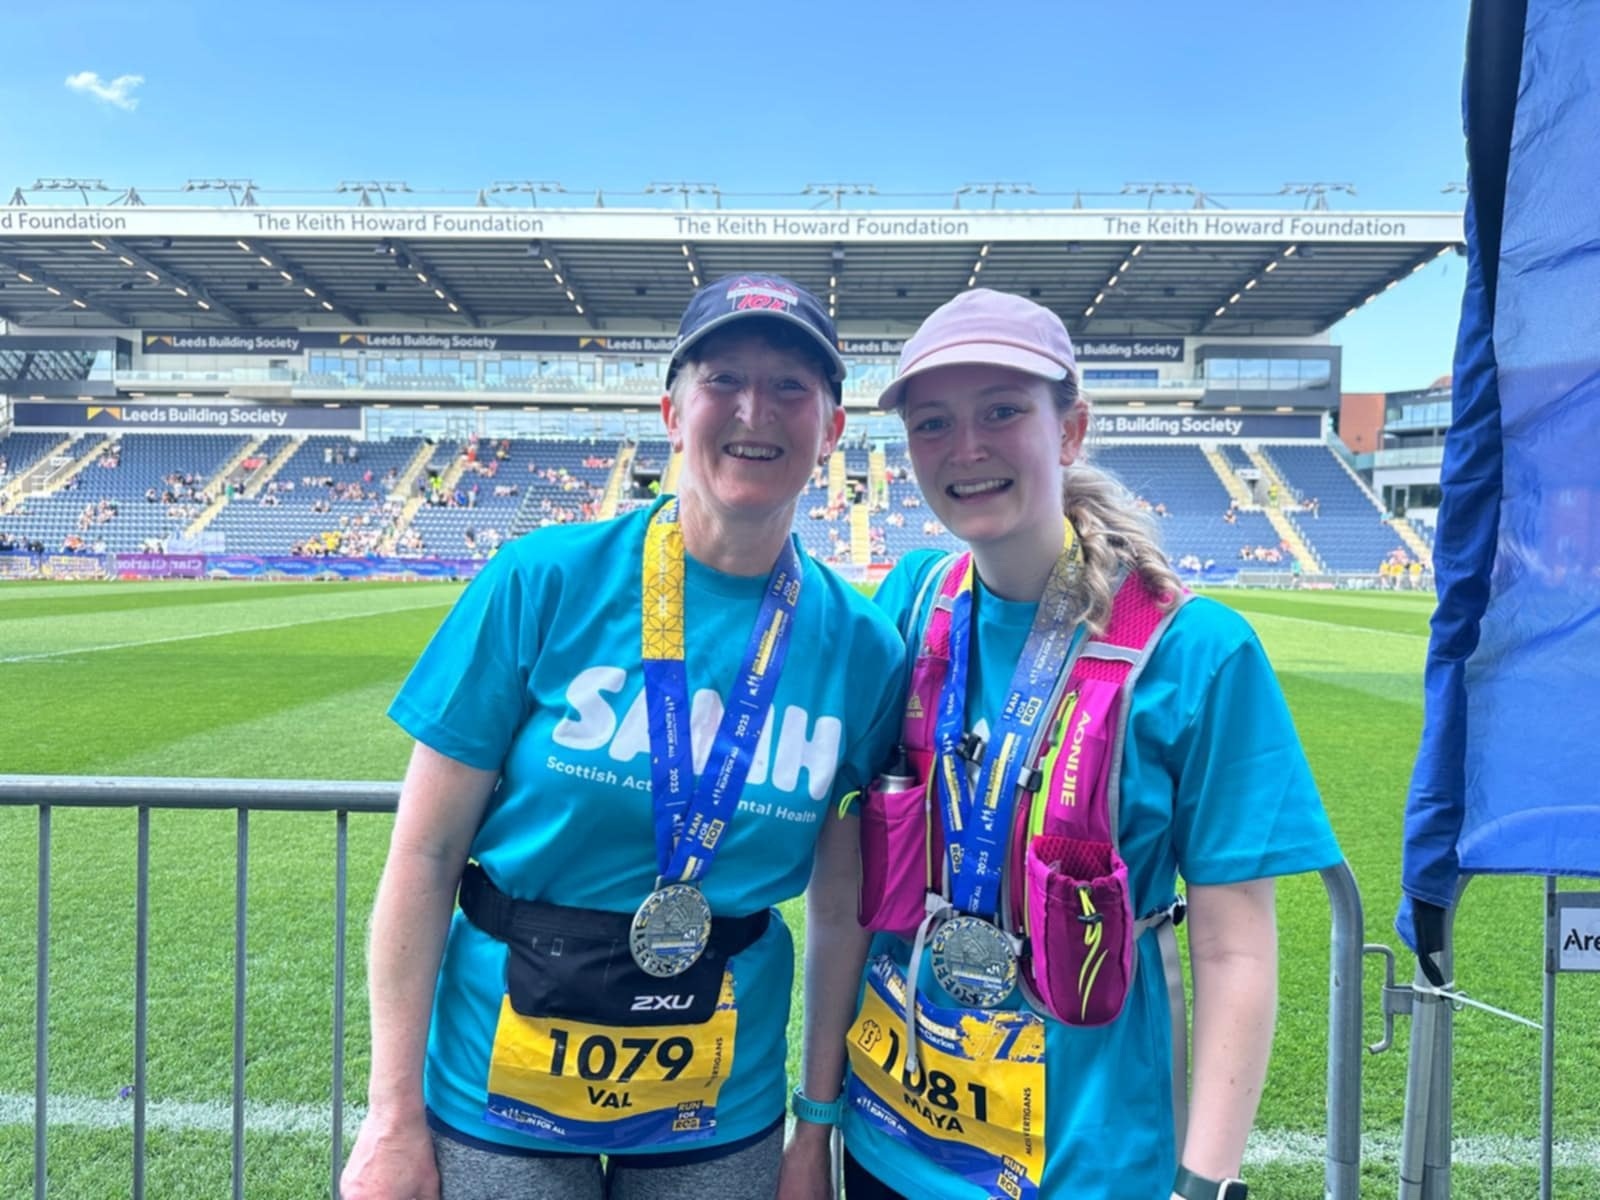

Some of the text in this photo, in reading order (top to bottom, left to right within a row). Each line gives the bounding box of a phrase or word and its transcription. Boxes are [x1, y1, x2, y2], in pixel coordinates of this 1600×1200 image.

[19, 213, 126, 229] Foundation
[254, 213, 543, 232] The Keith Howard Foundation
[674, 217, 969, 235] The Keith Howard Foundation
[1103, 217, 1406, 236] The Keith Howard Foundation
[172, 336, 300, 350] Leeds Building Society
[367, 335, 497, 350] Leeds Building Society
[607, 338, 643, 350] Leeds
[844, 341, 880, 353] Leeds
[1083, 343, 1132, 358] Building
[1133, 343, 1180, 358] Society
[121, 407, 287, 427] Leeds Building Society
[1116, 417, 1180, 436] Building
[1181, 417, 1243, 435] Society
[1007, 692, 1021, 713] RAN
[1015, 700, 1028, 719] FOR
[1021, 696, 1042, 725] ROB
[735, 713, 750, 737] 2025
[725, 758, 736, 775] FOR
[1061, 711, 1092, 807] AONIJIE
[546, 755, 817, 823] Scottish Act ntal Health
[669, 768, 680, 794] 2025
[690, 813, 704, 835] RAN
[698, 822, 709, 841] FOR
[703, 820, 724, 847] ROB
[976, 850, 989, 876] 2025
[1563, 928, 1600, 952] Are
[924, 1029, 956, 1050] Clarion
[550, 1028, 694, 1083] 1079
[882, 1028, 988, 1122] 1081
[587, 1086, 633, 1109] VAL
[678, 1101, 701, 1112] RUN
[679, 1111, 695, 1120] FOR
[903, 1093, 965, 1134] MAYA
[536, 1119, 552, 1130] FOR
[552, 1125, 567, 1136] ALL
[1003, 1157, 1025, 1175] RUN
[1005, 1169, 1018, 1182] FOR
[1000, 1176, 1020, 1198] ROB
